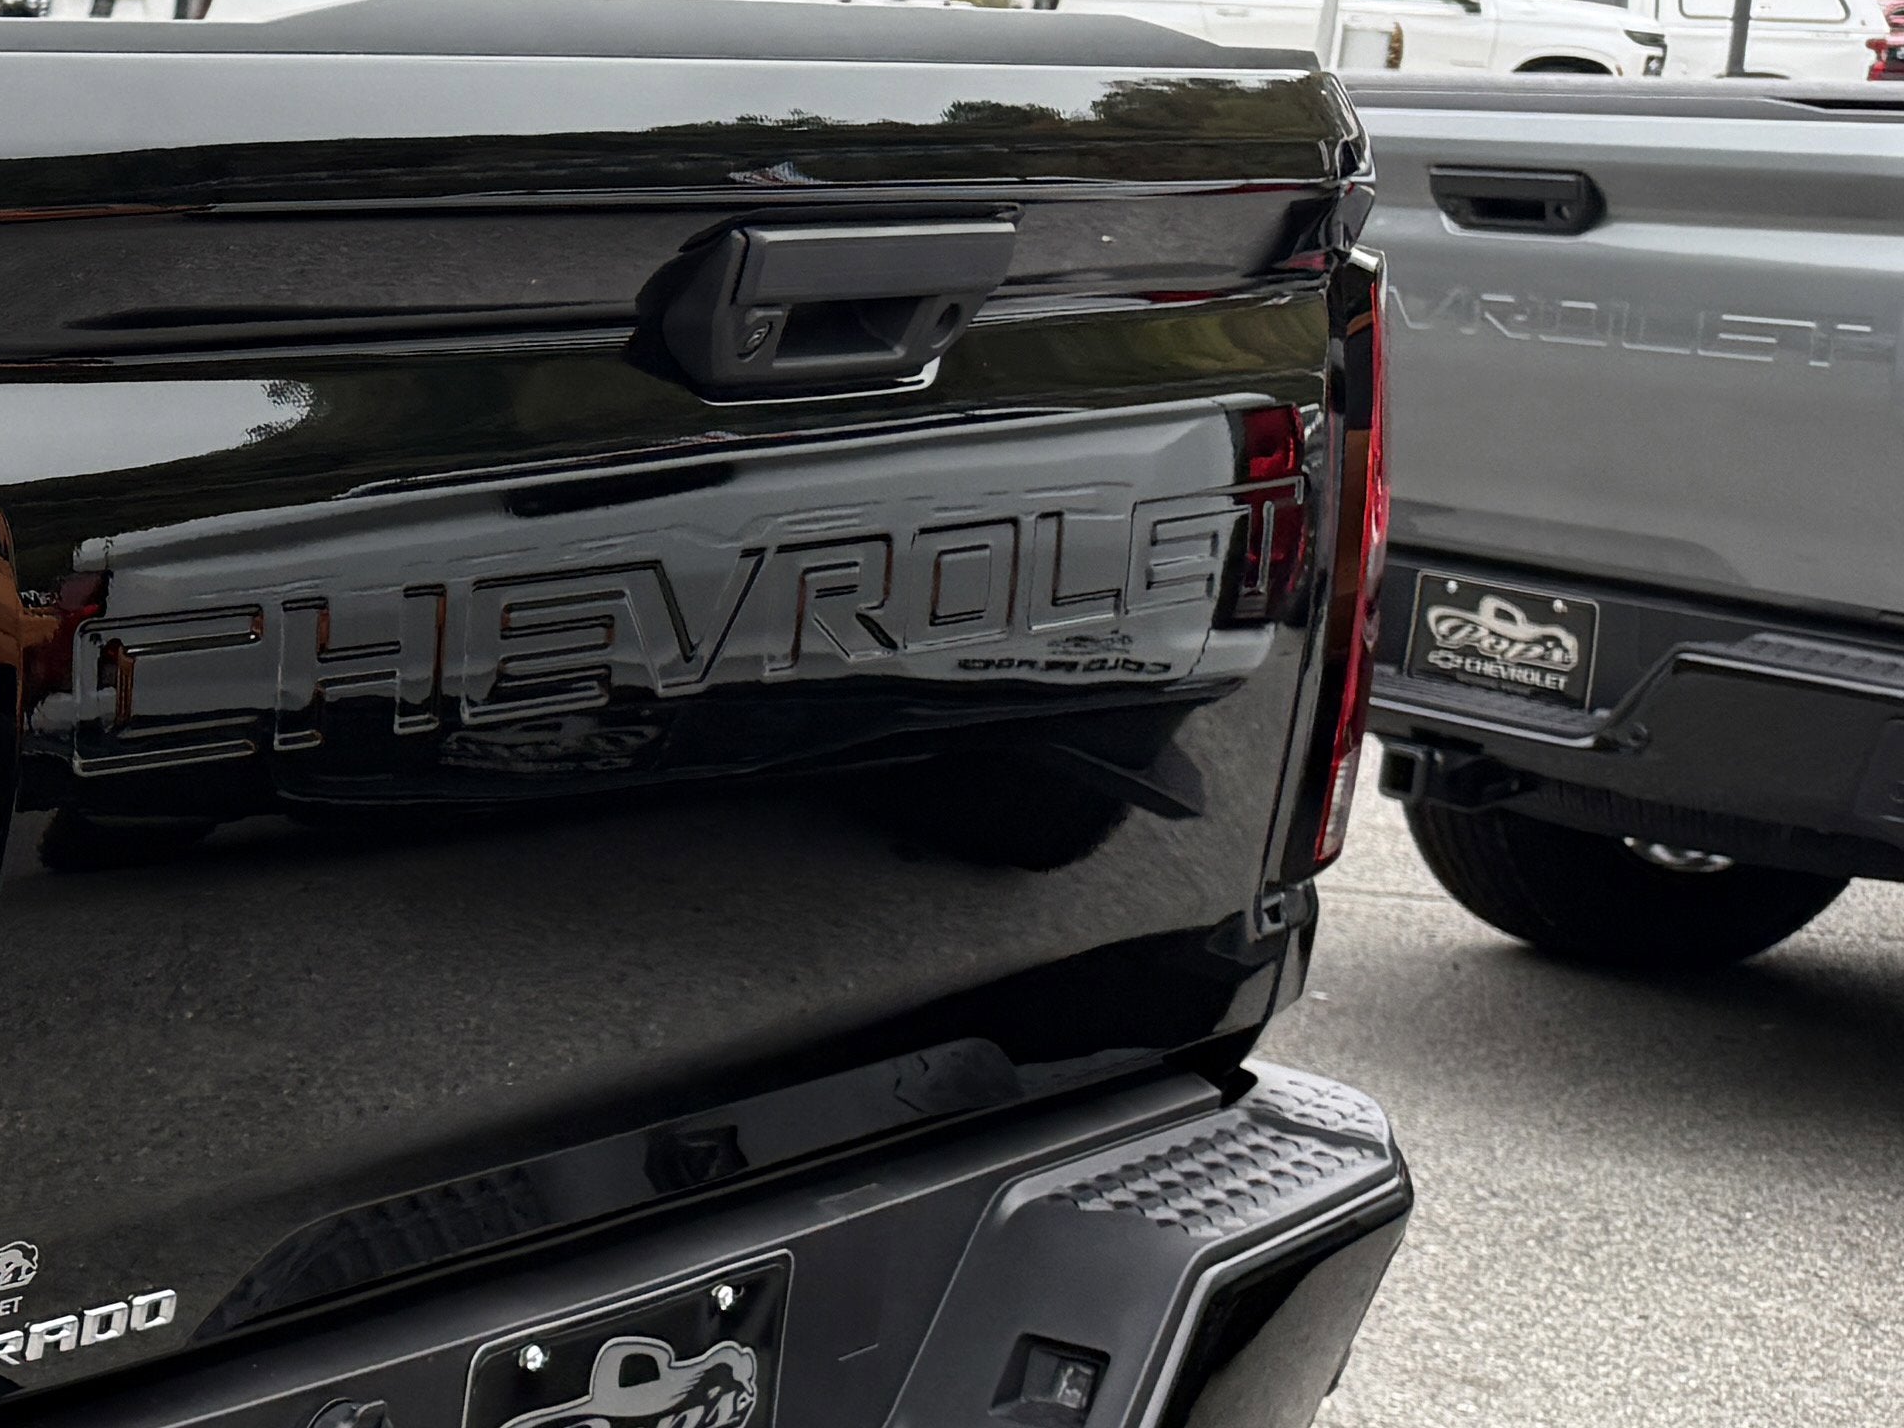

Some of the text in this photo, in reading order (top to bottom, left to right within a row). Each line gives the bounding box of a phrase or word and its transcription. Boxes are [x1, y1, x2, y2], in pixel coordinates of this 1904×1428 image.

[1387, 284, 1872, 369] VROLET
[72, 472, 1306, 776] CHEVROLET
[1463, 656, 1569, 691] CHEVROLET
